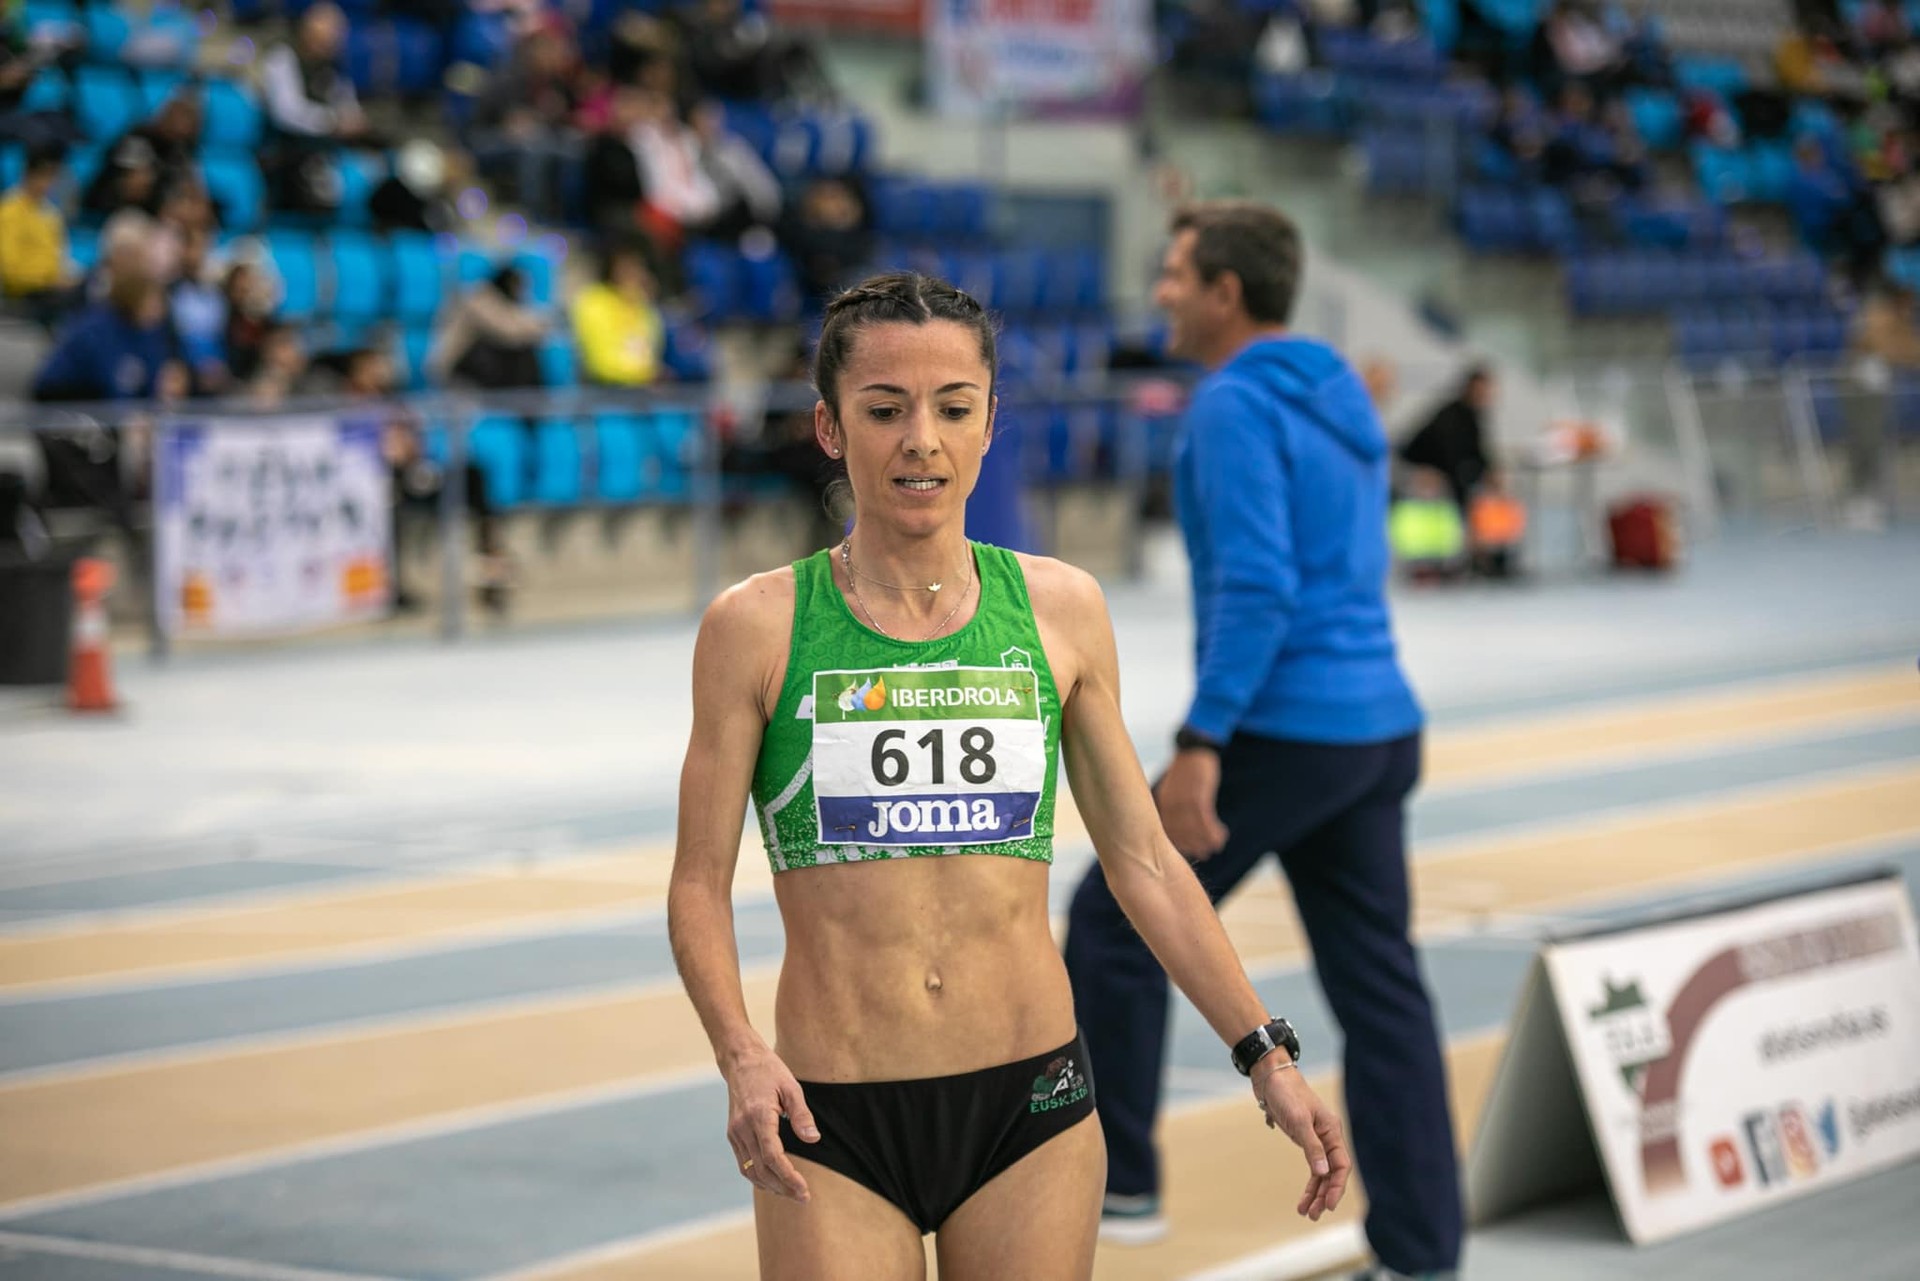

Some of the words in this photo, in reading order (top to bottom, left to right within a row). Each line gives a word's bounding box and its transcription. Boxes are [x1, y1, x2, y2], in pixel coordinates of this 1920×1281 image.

[892, 687, 1020, 707] IBERDROLA
[871, 726, 997, 786] 618
[1030, 1087, 1089, 1113] EUSKAD
